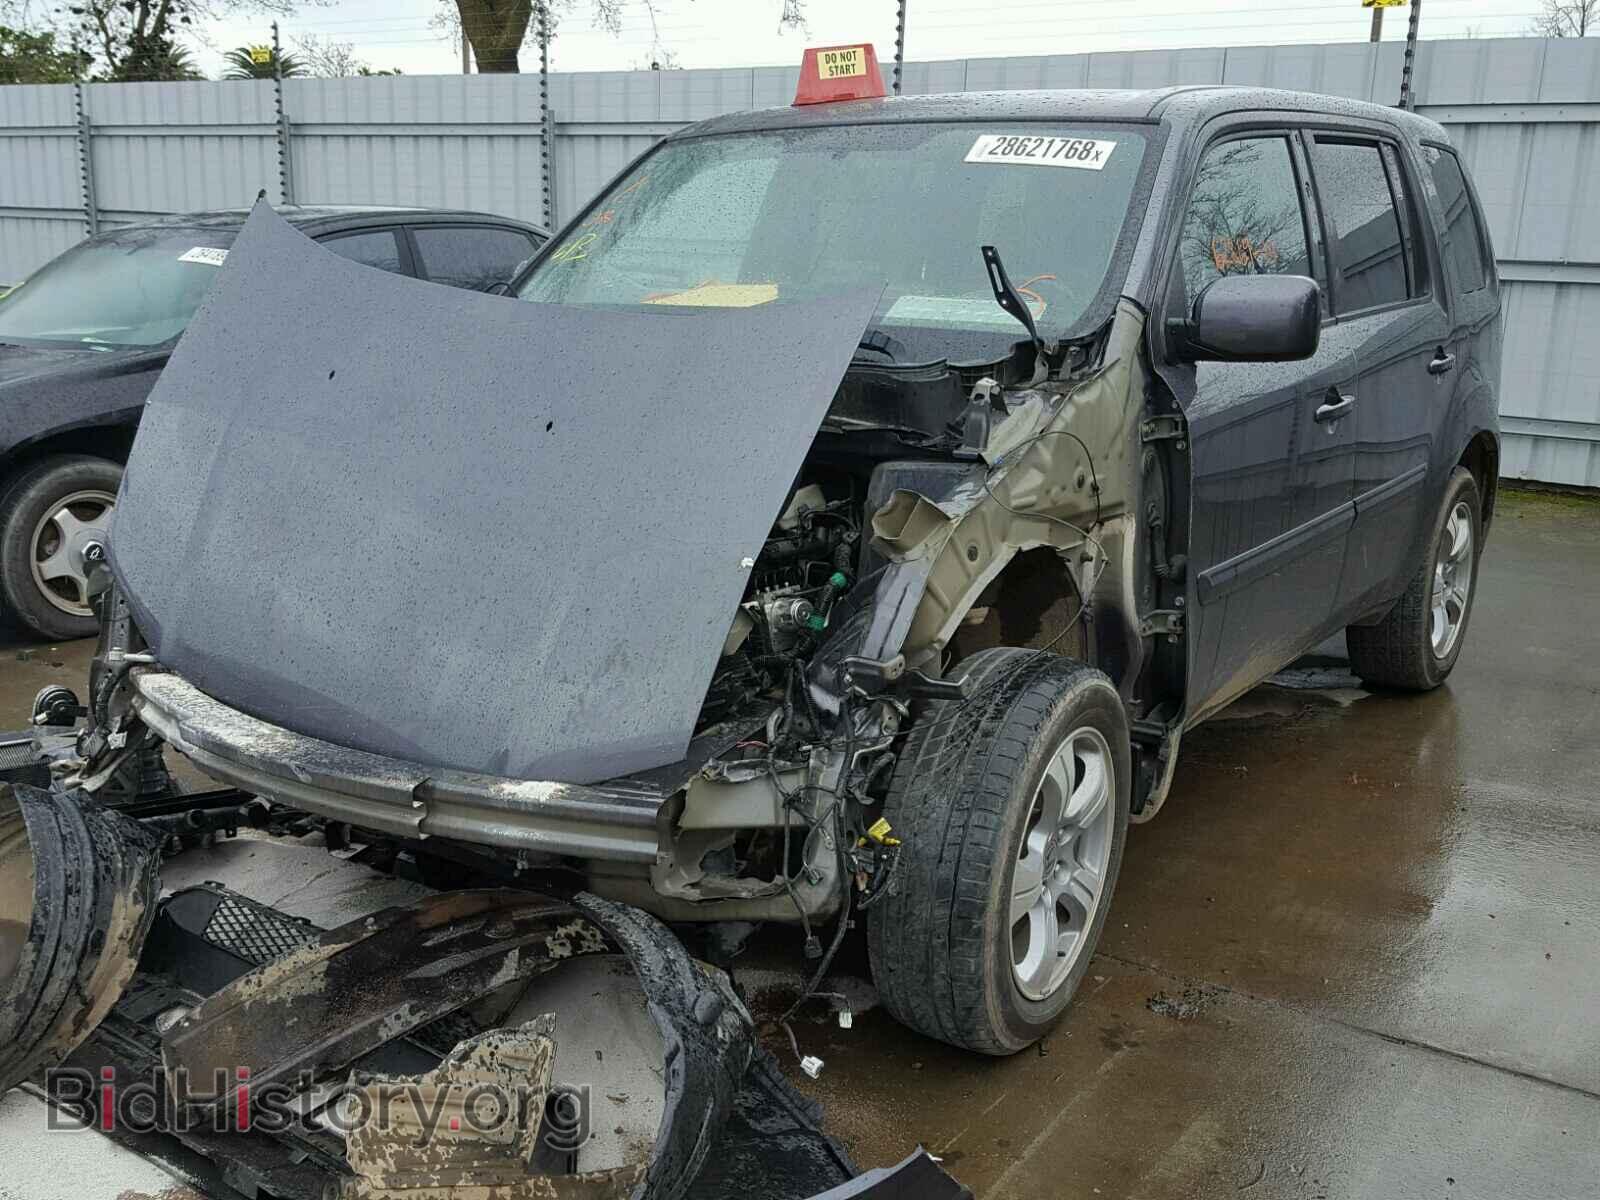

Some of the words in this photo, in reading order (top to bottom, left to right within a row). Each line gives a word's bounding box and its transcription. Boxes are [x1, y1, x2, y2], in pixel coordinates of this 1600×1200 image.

[824, 52, 837, 65] DO
[839, 50, 857, 62] NOT
[828, 63, 856, 77] START
